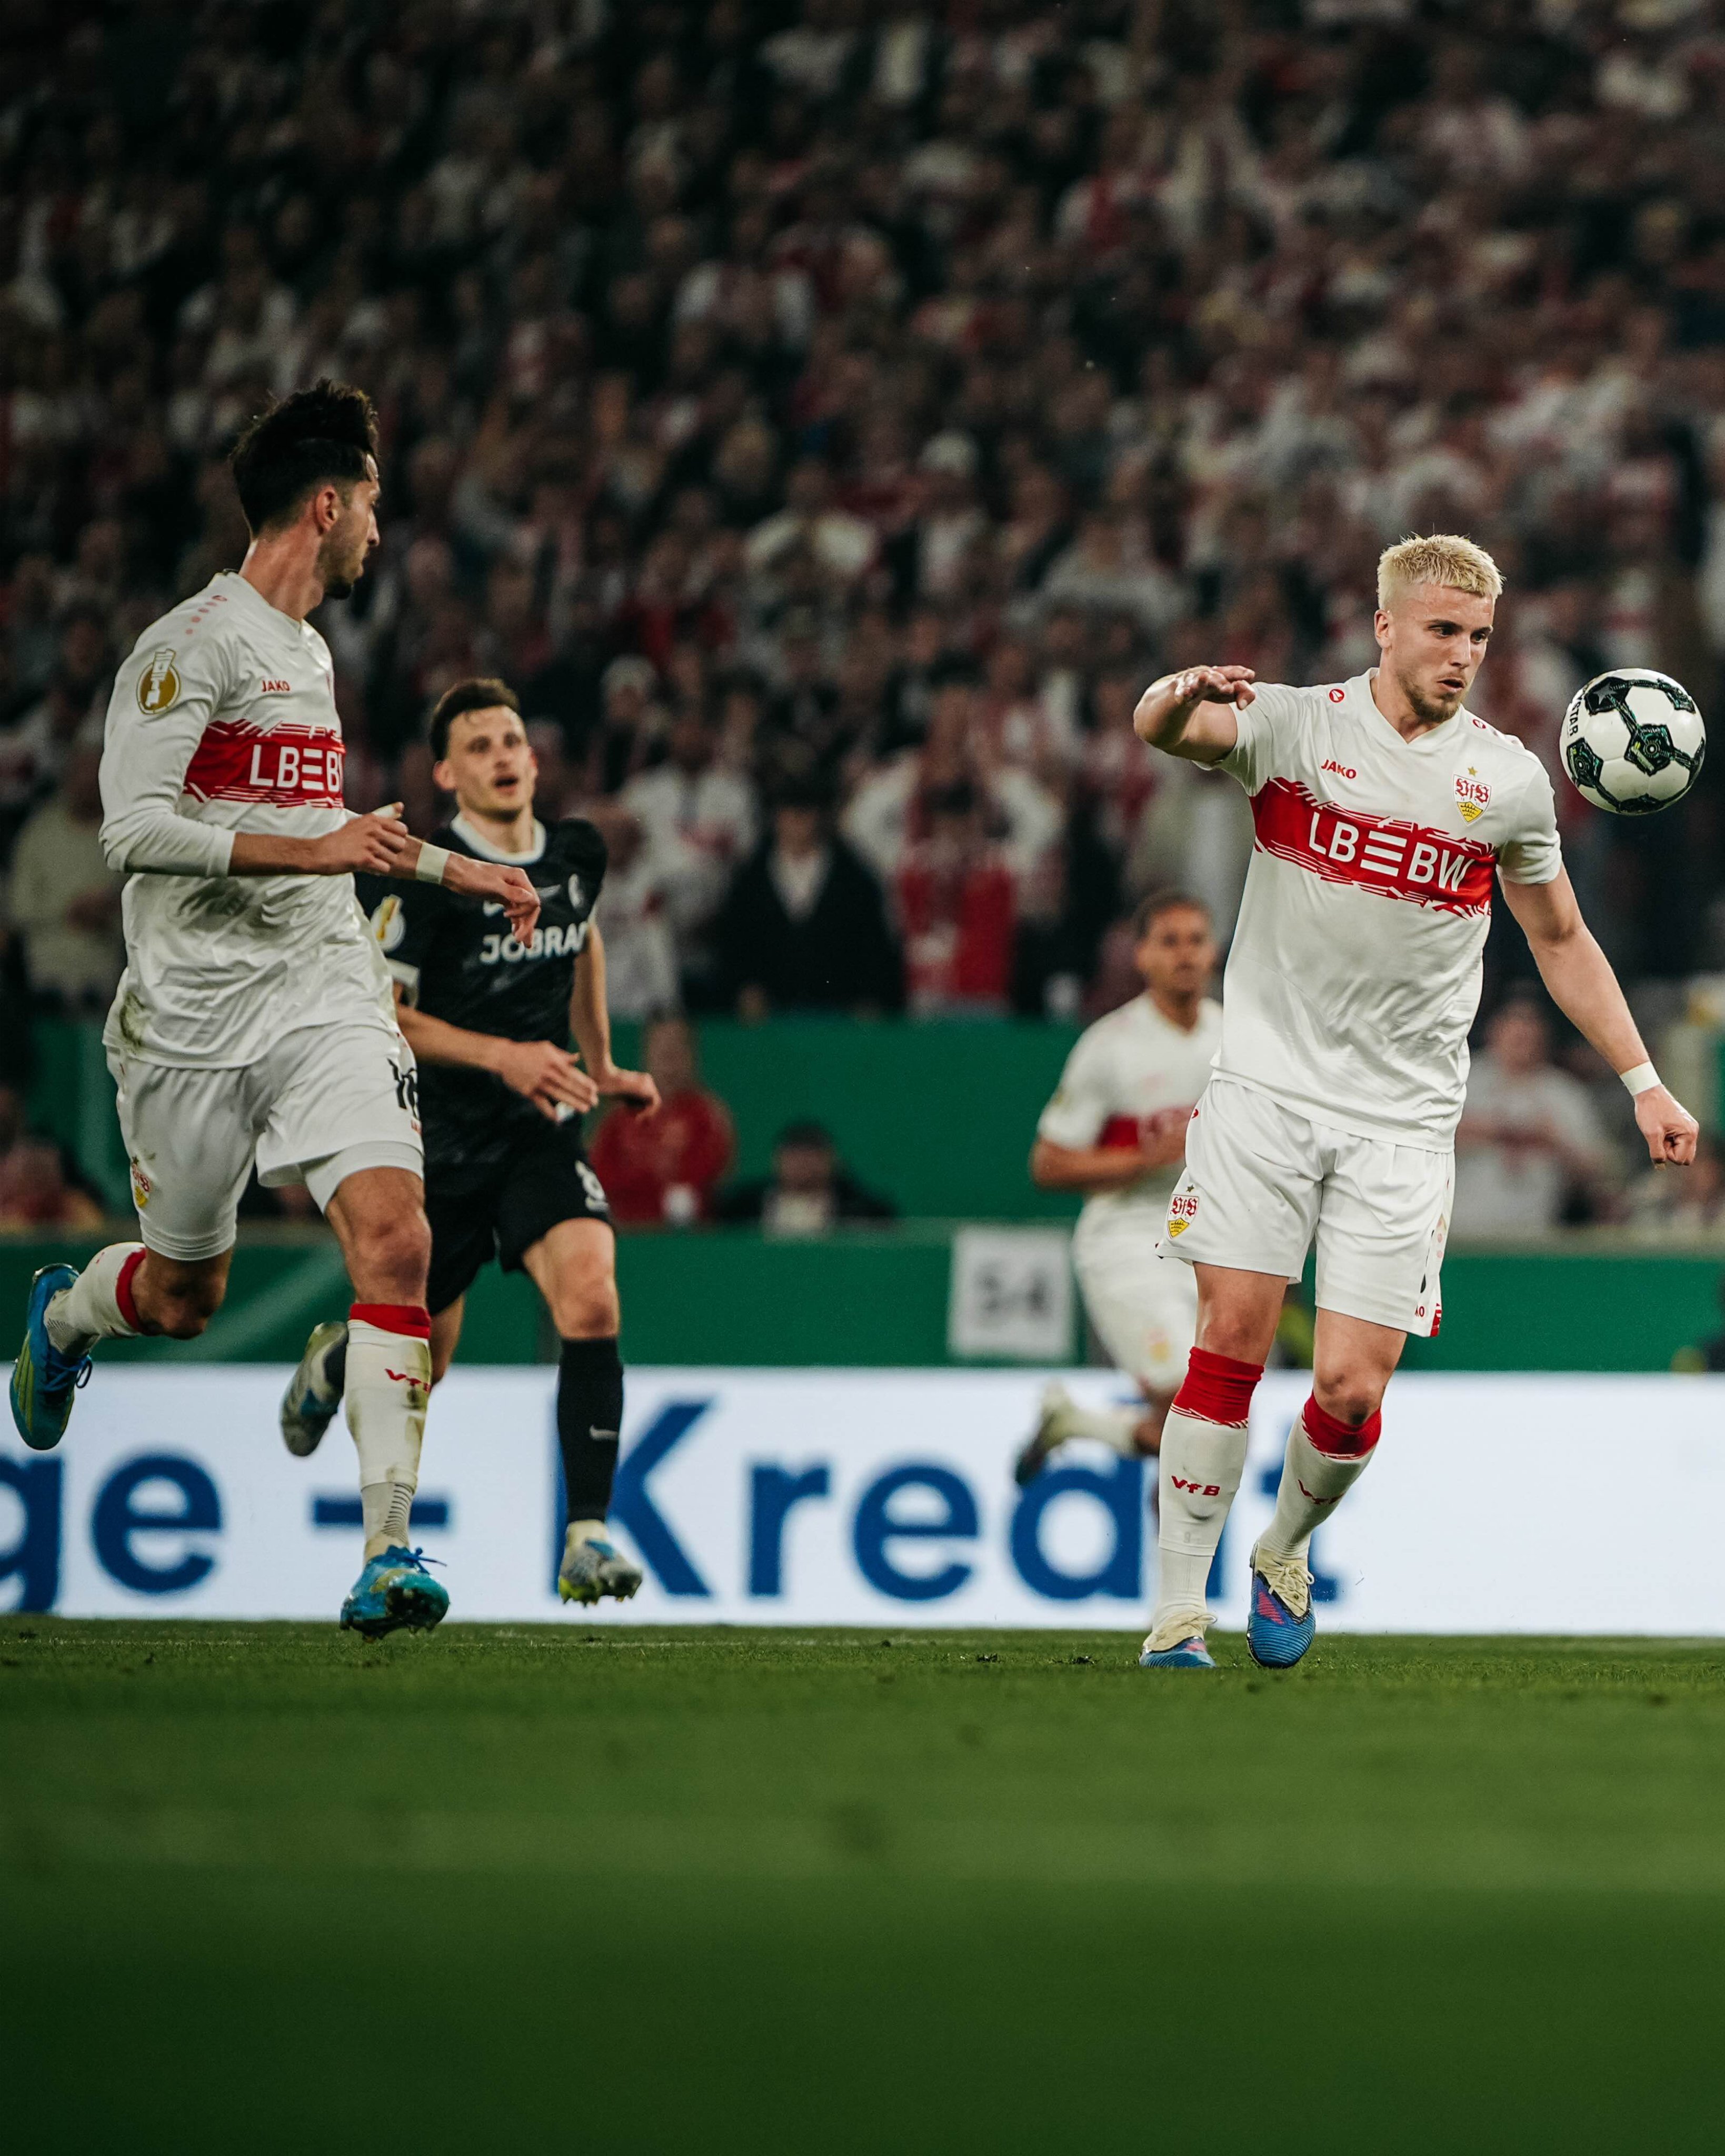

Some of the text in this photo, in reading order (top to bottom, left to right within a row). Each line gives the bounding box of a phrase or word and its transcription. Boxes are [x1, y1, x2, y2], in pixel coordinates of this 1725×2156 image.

[262, 680, 290, 692] JAKO
[1321, 759, 1357, 780] JAKO
[1171, 1475, 1221, 1496] VfB
